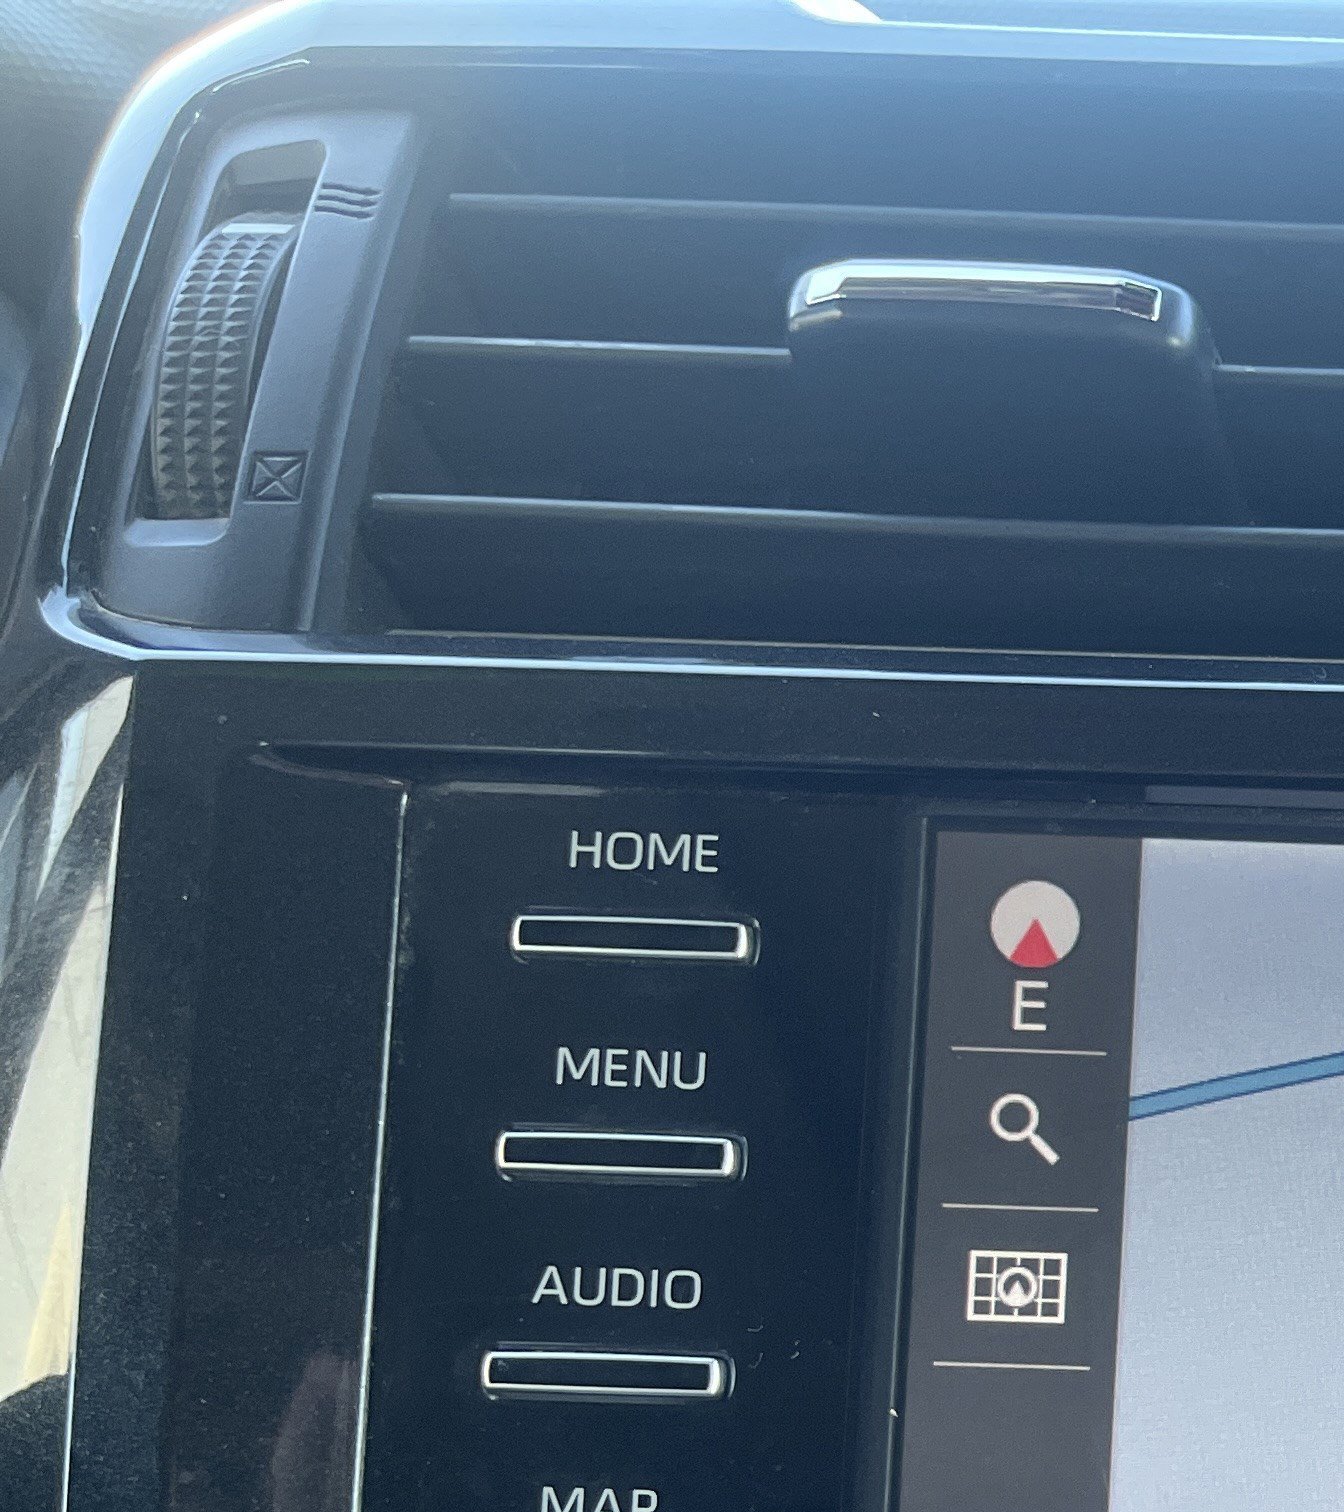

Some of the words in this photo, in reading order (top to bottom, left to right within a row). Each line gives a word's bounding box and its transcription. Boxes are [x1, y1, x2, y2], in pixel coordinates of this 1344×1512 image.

[568, 830, 719, 873] HOME
[1013, 981, 1049, 1032] E
[555, 1046, 708, 1091] MENU
[532, 1264, 703, 1310] AUDIO
